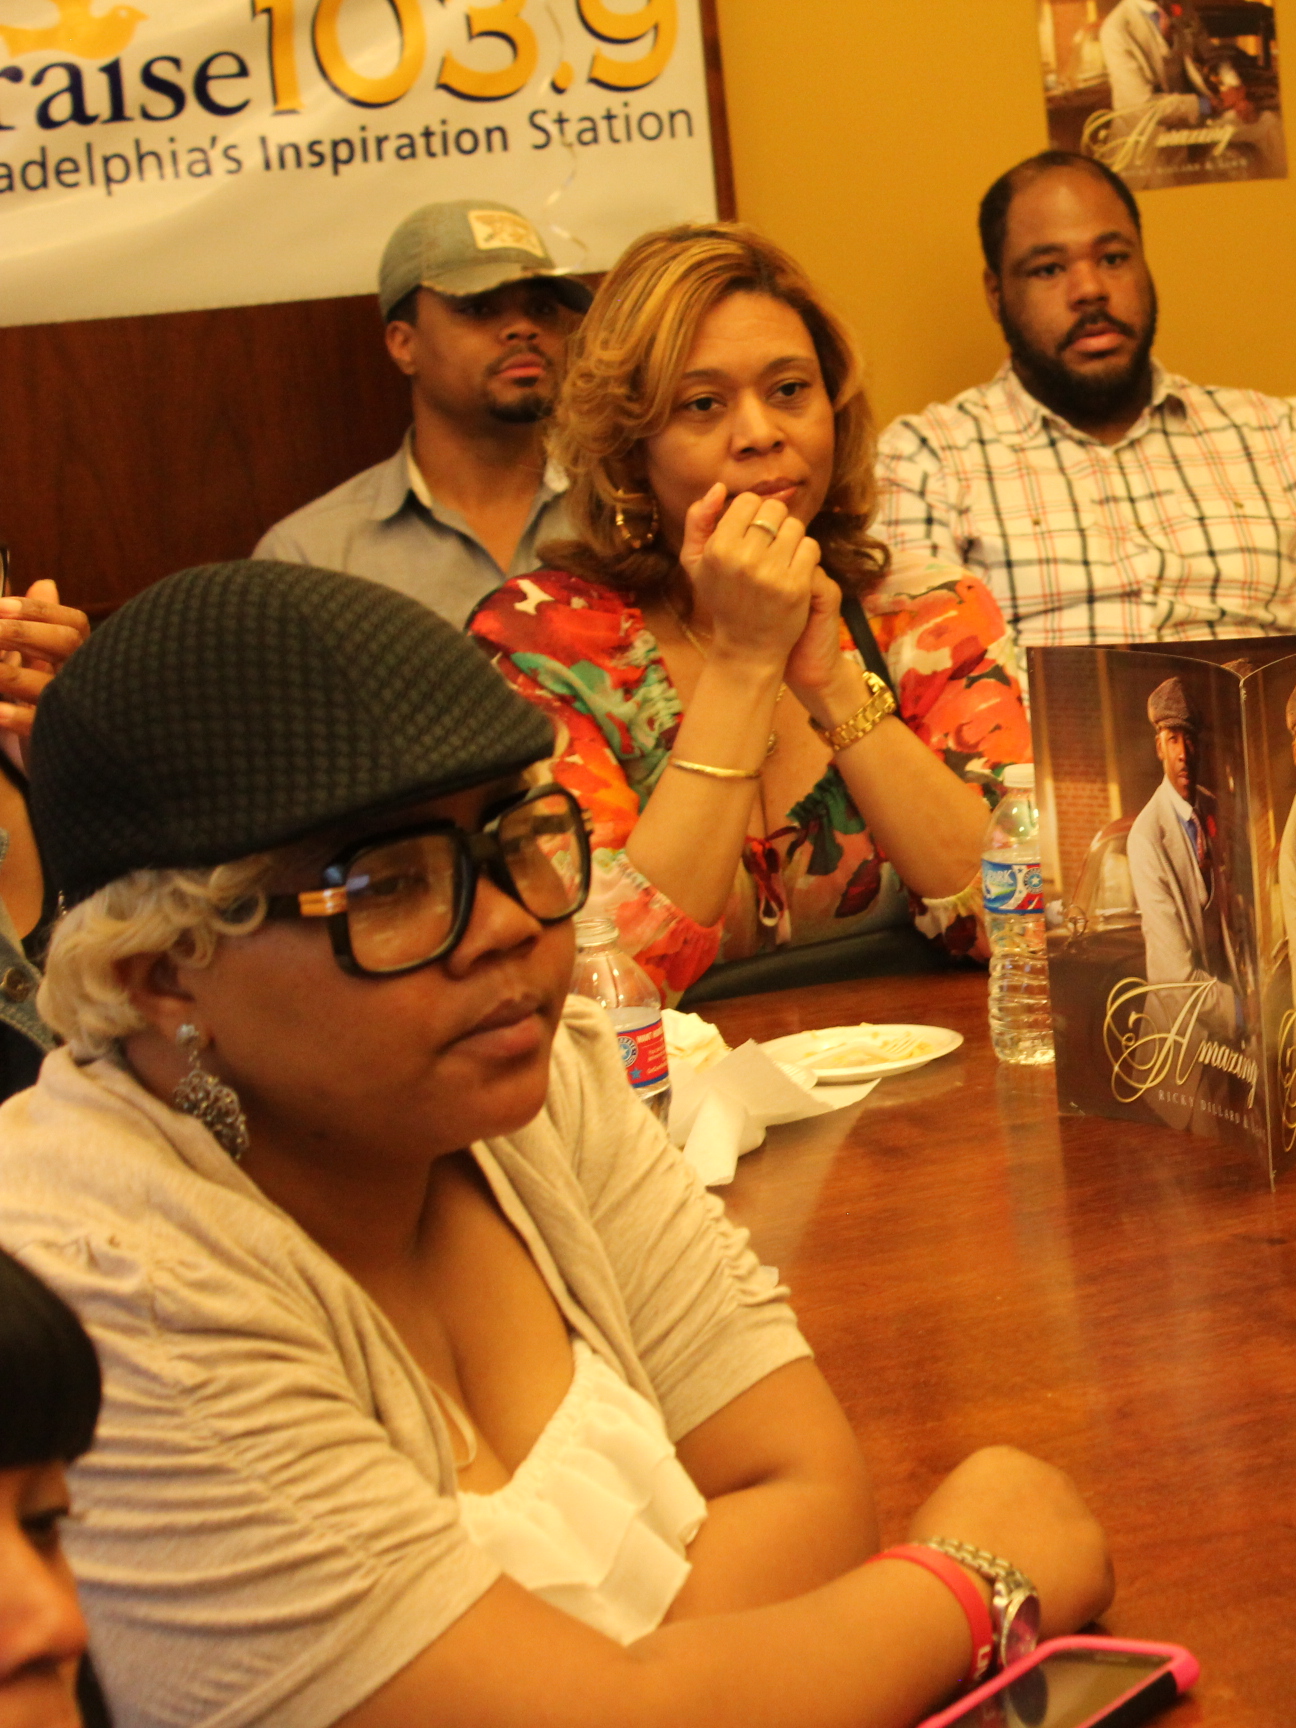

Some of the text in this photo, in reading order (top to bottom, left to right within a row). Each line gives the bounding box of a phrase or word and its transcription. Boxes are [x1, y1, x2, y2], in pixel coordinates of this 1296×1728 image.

[251, 0, 680, 116] 103.9
[259, 119, 509, 176] Inspiration
[528, 101, 694, 150] Station
[1103, 976, 1258, 1109] Amazing
[1158, 1089, 1195, 1108] RICKY
[1200, 1099, 1240, 1124] DILLARD
